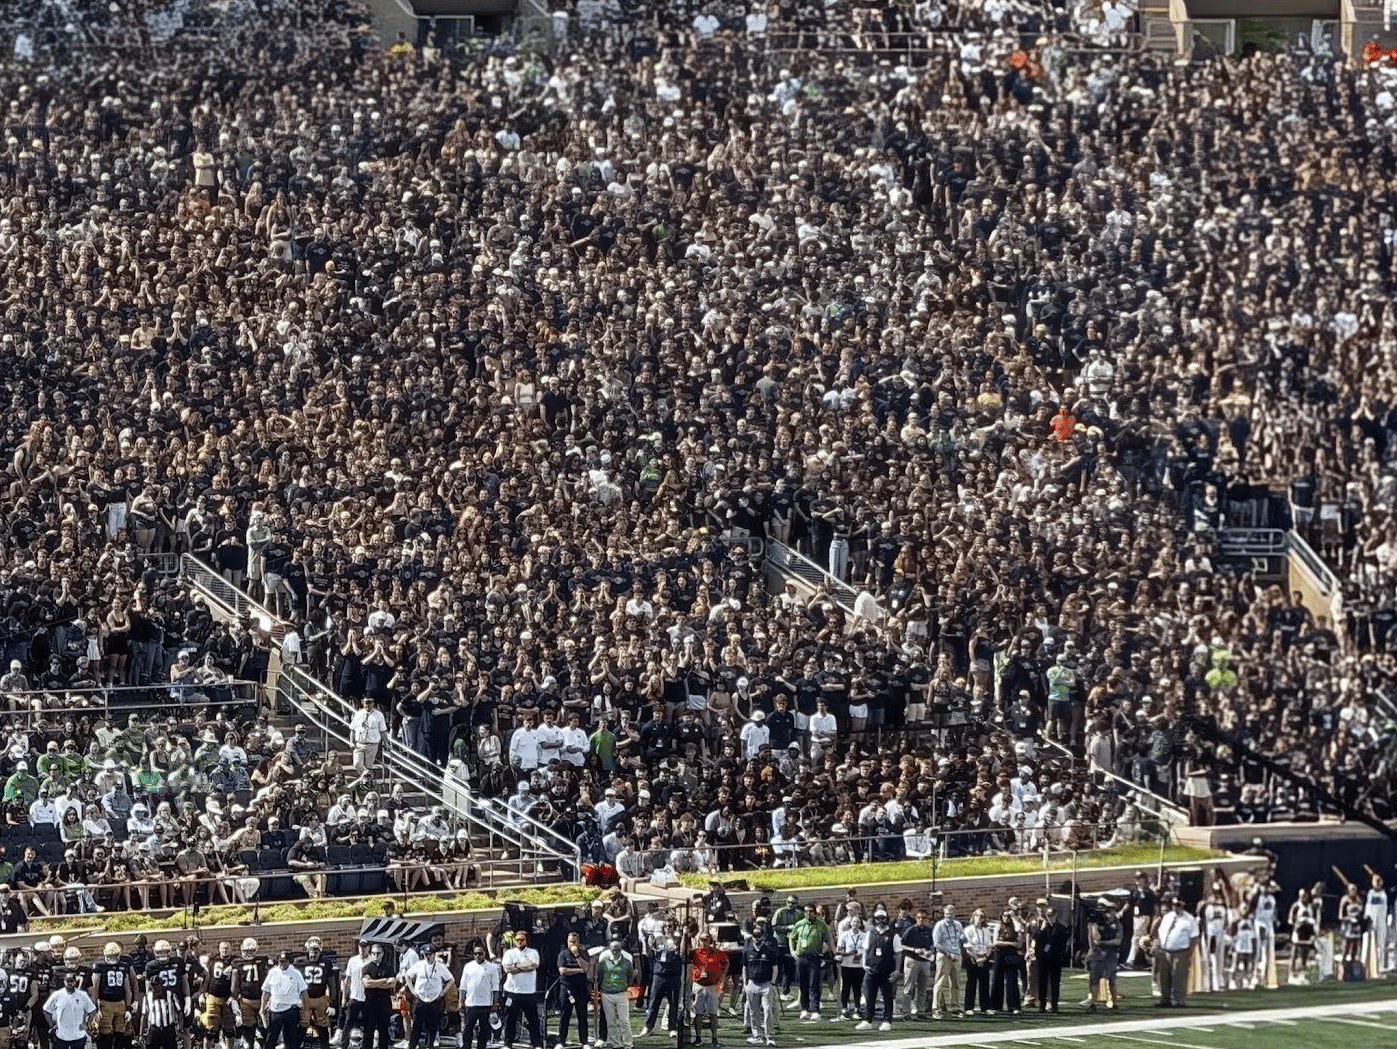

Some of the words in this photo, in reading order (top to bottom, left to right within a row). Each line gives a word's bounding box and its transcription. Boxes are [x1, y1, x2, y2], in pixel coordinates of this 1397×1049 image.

[242, 963, 259, 982] 71
[304, 965, 323, 984] 52
[9, 974, 29, 993] 50
